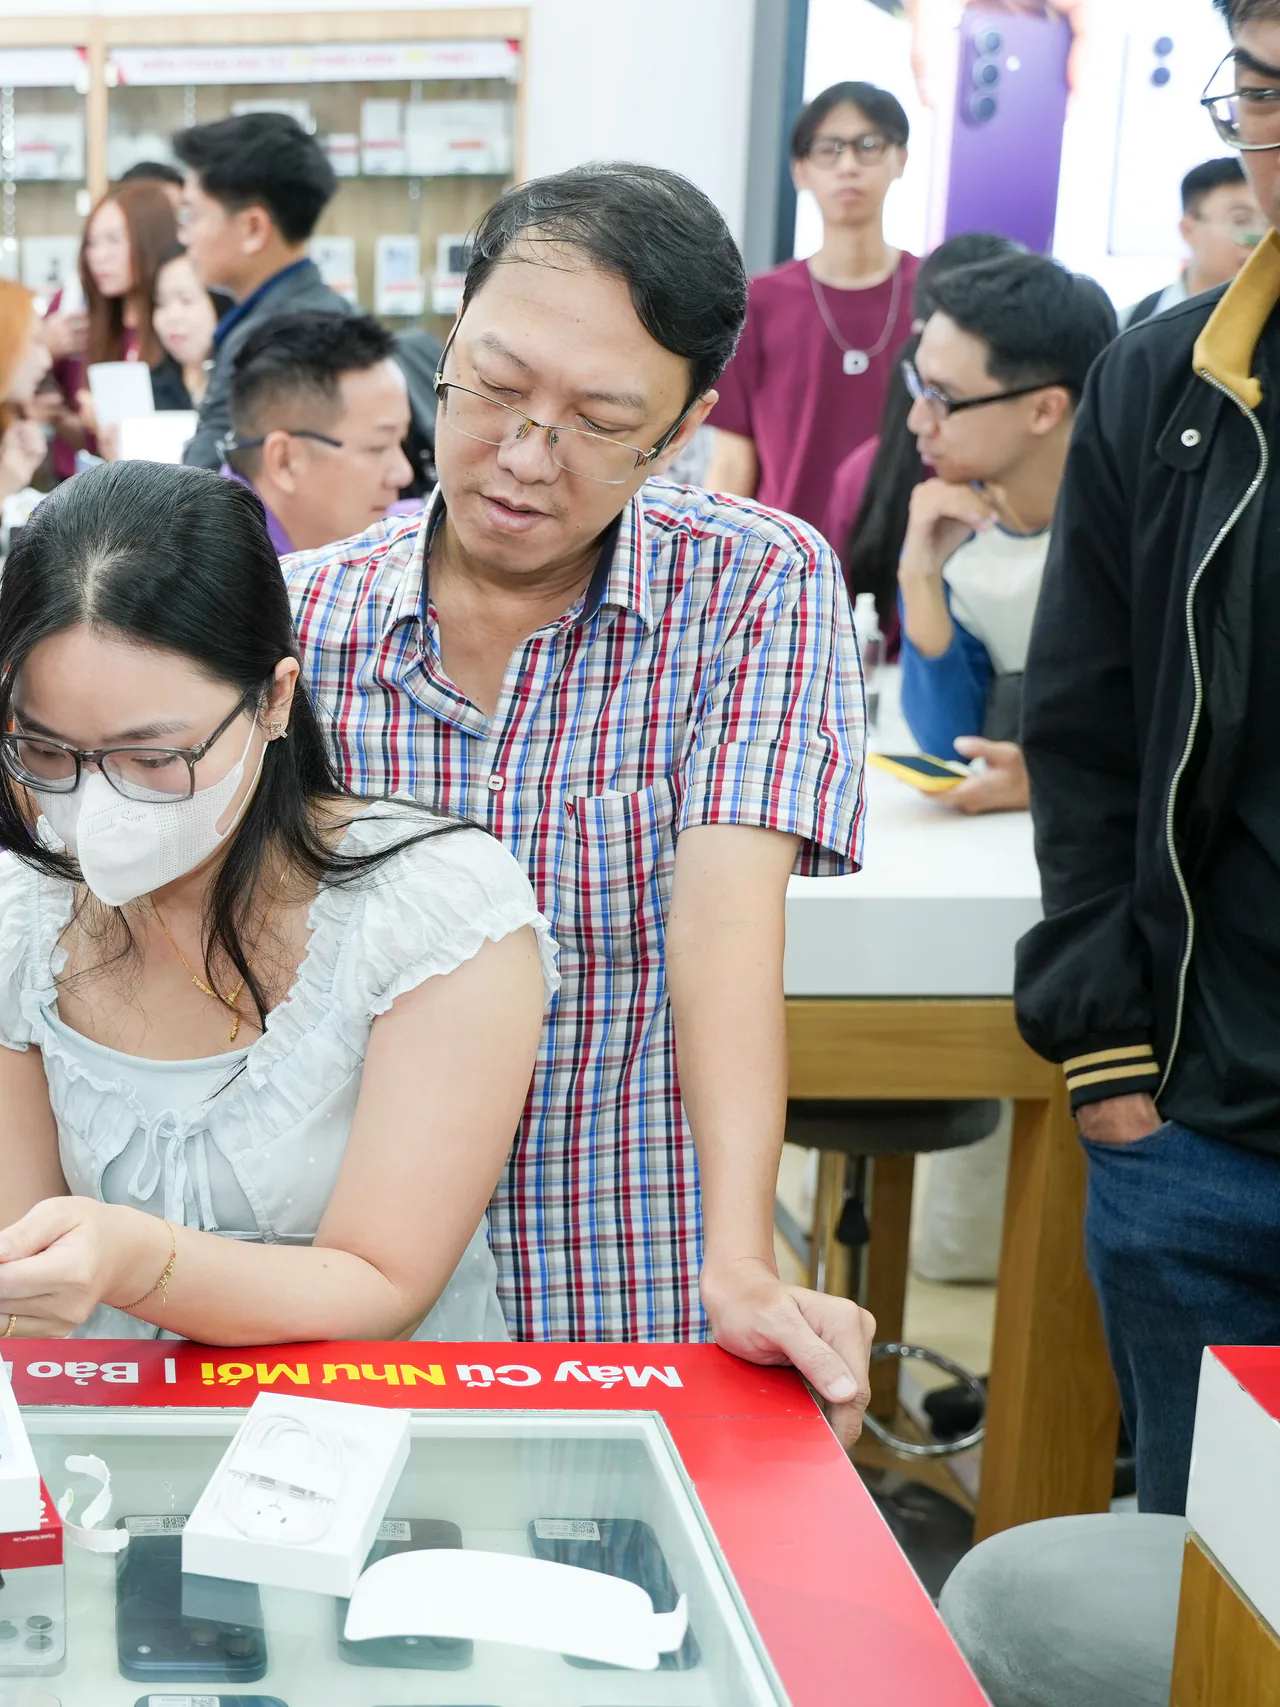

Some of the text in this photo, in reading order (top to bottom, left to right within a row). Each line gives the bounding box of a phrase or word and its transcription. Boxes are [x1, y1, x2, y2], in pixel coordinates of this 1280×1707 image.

[26, 1361, 139, 1386] Bảo
[202, 1362, 310, 1387] Mới
[322, 1362, 446, 1386] Như
[456, 1363, 541, 1388] Cũ
[554, 1361, 685, 1389] Máy
